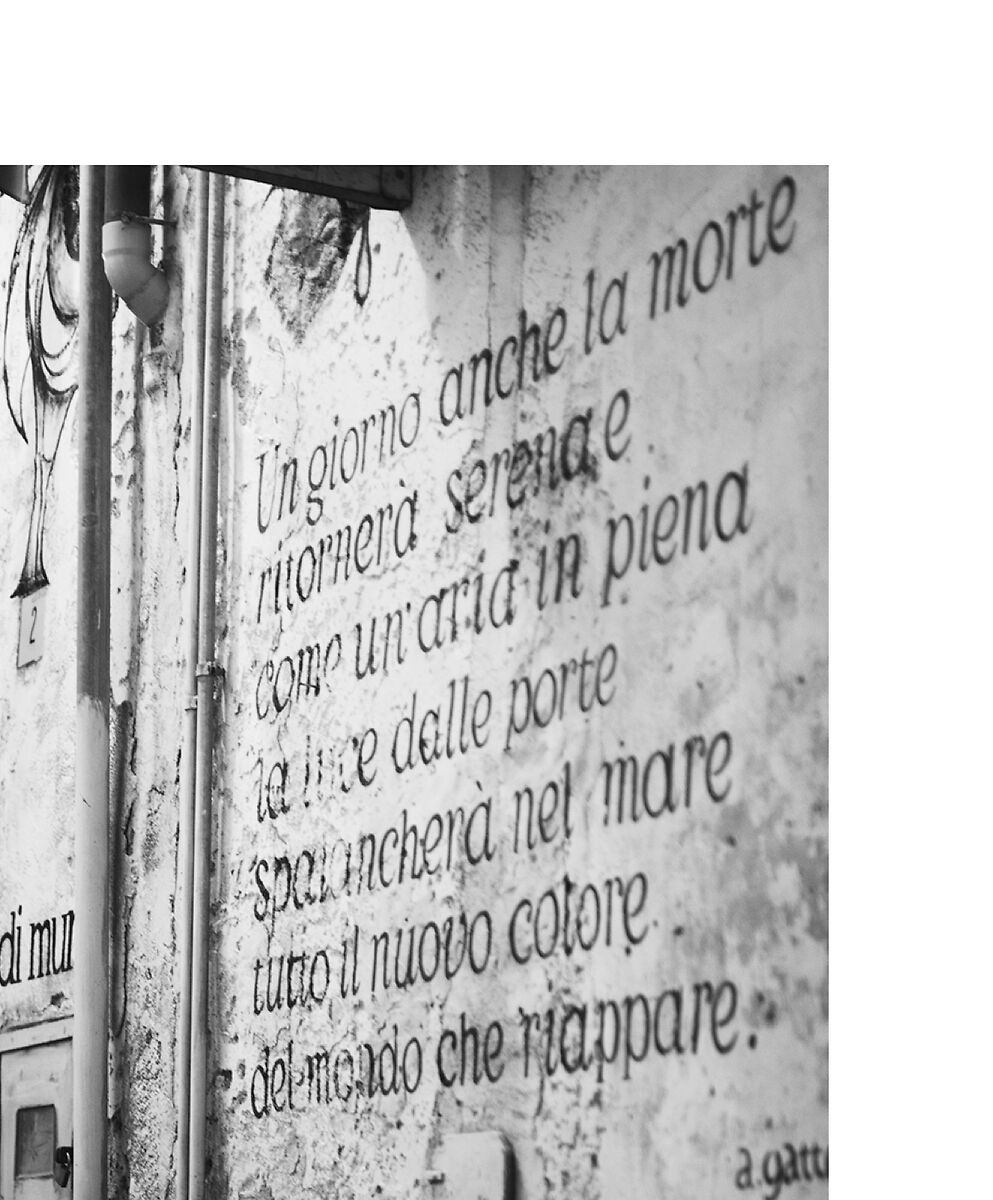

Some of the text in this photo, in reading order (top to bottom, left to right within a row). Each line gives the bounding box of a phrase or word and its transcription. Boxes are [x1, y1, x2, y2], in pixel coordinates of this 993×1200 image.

[256, 176, 797, 533] Un giorno anche la morte
[257, 389, 630, 624] ritornerà serena e
[29, 605, 38, 645] 2
[256, 634, 342, 720] come
[537, 520, 583, 610] in
[599, 461, 751, 608] piena
[253, 757, 290, 822] la
[391, 681, 494, 776] dalle
[505, 643, 617, 753] porte
[511, 762, 573, 853] nel
[600, 730, 733, 827] mare
[253, 870, 649, 1016] tutto il nuovo colore
[250, 978, 757, 1119] del mondo che riappare.
